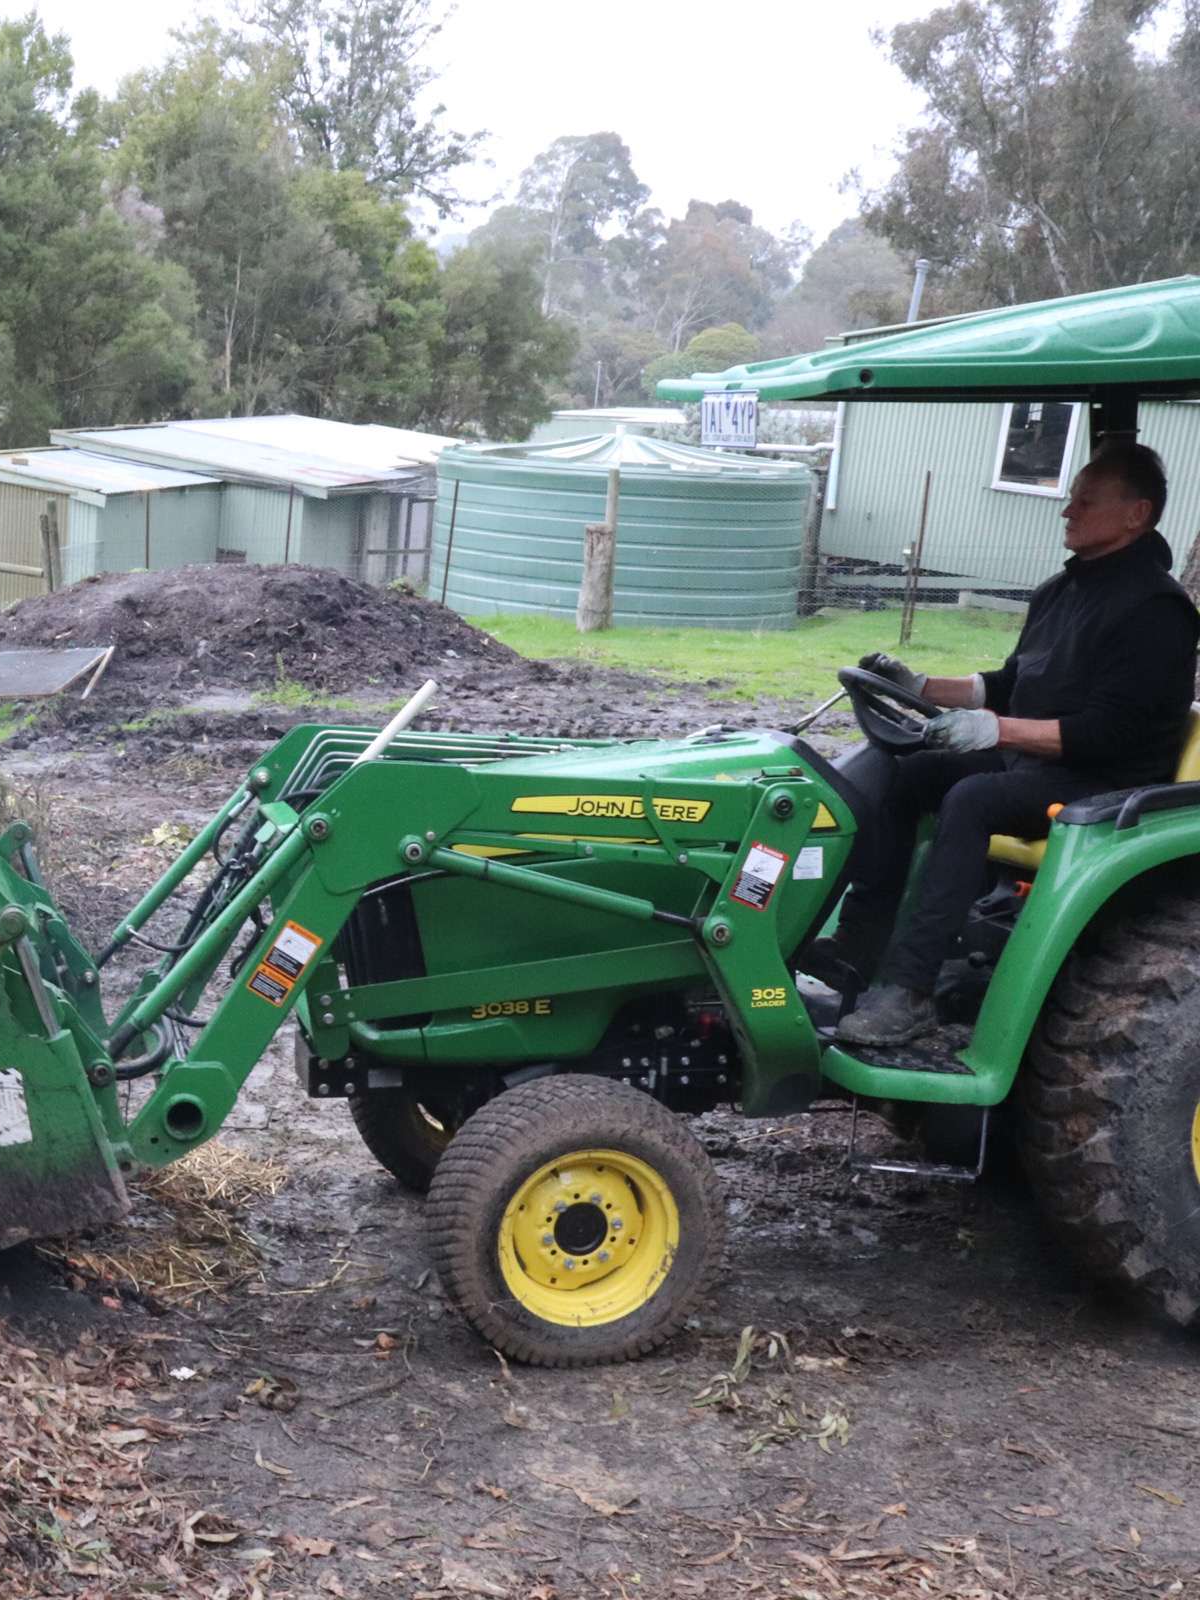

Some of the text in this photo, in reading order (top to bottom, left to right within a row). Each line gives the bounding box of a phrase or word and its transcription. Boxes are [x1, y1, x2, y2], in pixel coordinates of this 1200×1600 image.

[568, 797, 699, 819] JOHN DERE
[751, 987, 786, 1000] 305
[471, 1001, 529, 1019] 3038
[751, 1000, 786, 1008] LOADER
